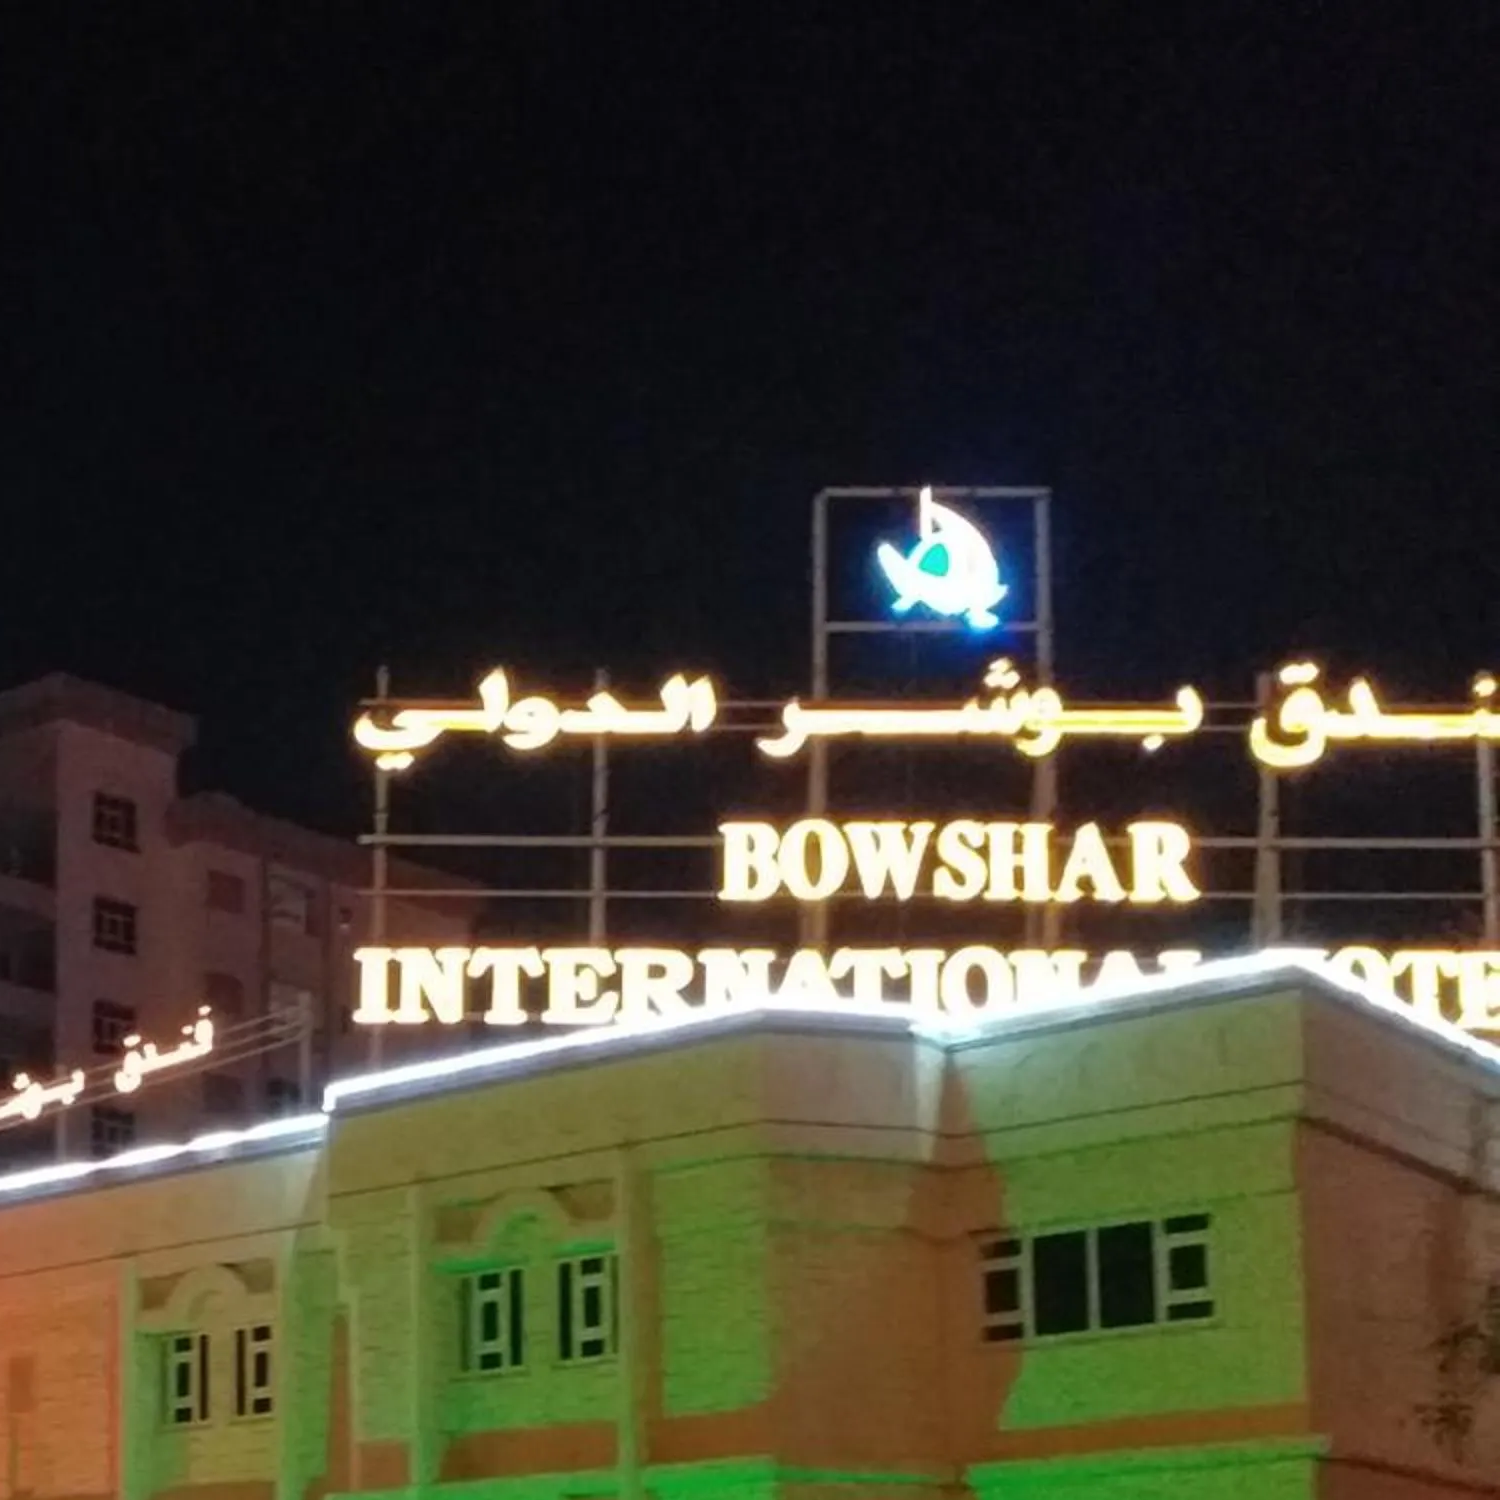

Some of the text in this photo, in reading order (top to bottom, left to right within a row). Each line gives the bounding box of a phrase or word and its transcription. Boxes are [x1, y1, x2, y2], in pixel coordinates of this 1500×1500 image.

[355, 657, 1500, 770] ندق بوشر الدولي
[718, 819, 1200, 902] BOWSHAR
